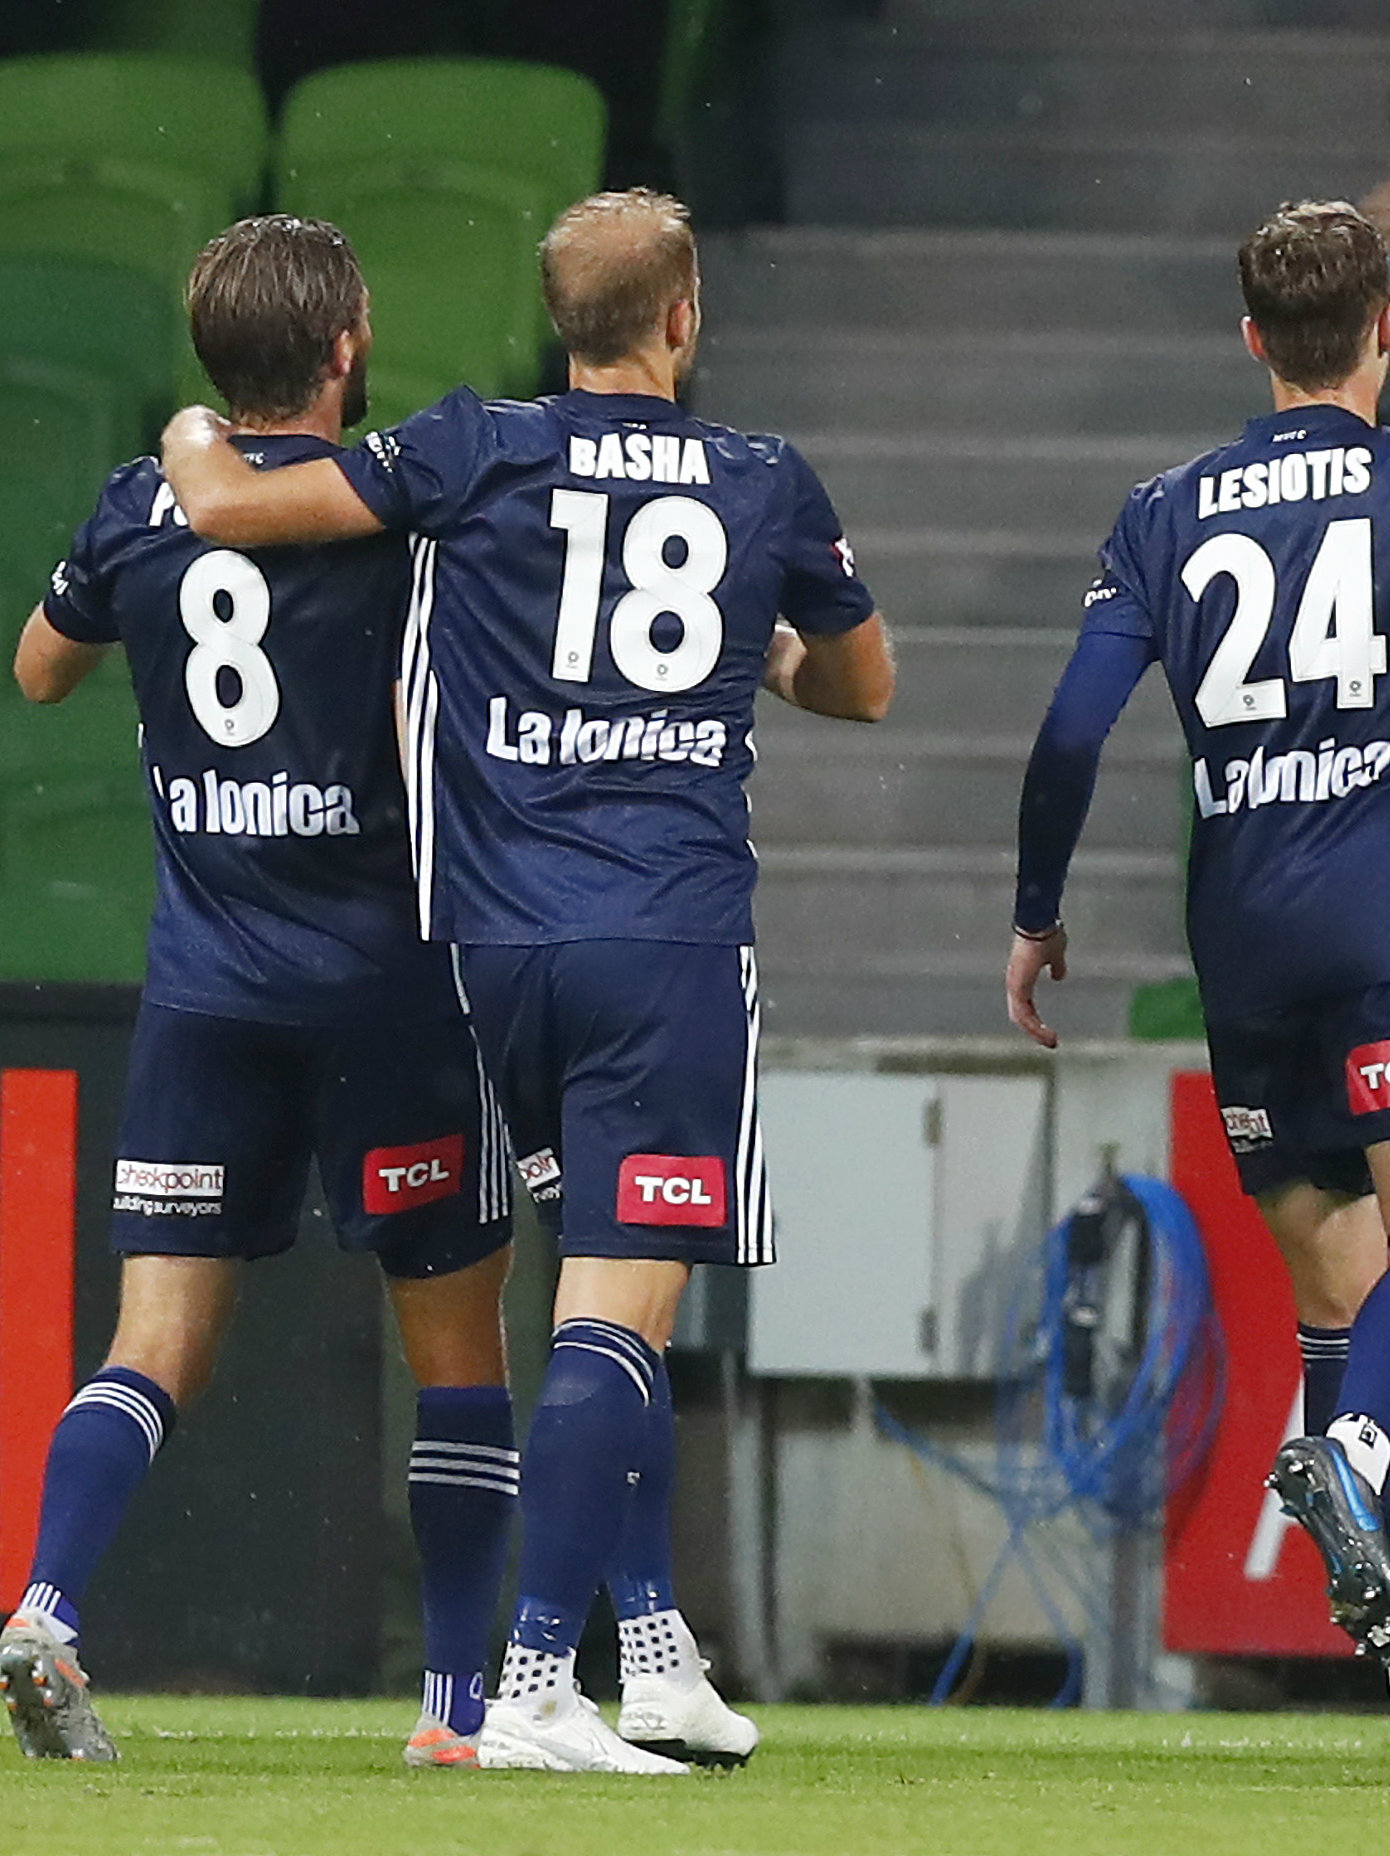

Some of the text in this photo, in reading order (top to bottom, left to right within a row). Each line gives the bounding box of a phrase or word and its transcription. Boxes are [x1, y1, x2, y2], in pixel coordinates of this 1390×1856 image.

[569, 433, 711, 484] BASHA
[1198, 447, 1372, 519] LESIOTIS
[550, 489, 727, 693] 18
[1181, 518, 1387, 728] 24
[180, 549, 280, 747] 8
[486, 697, 552, 765] La
[1195, 757, 1250, 819] La
[379, 1158, 449, 1192] TCL
[635, 1176, 712, 1205] TCL
